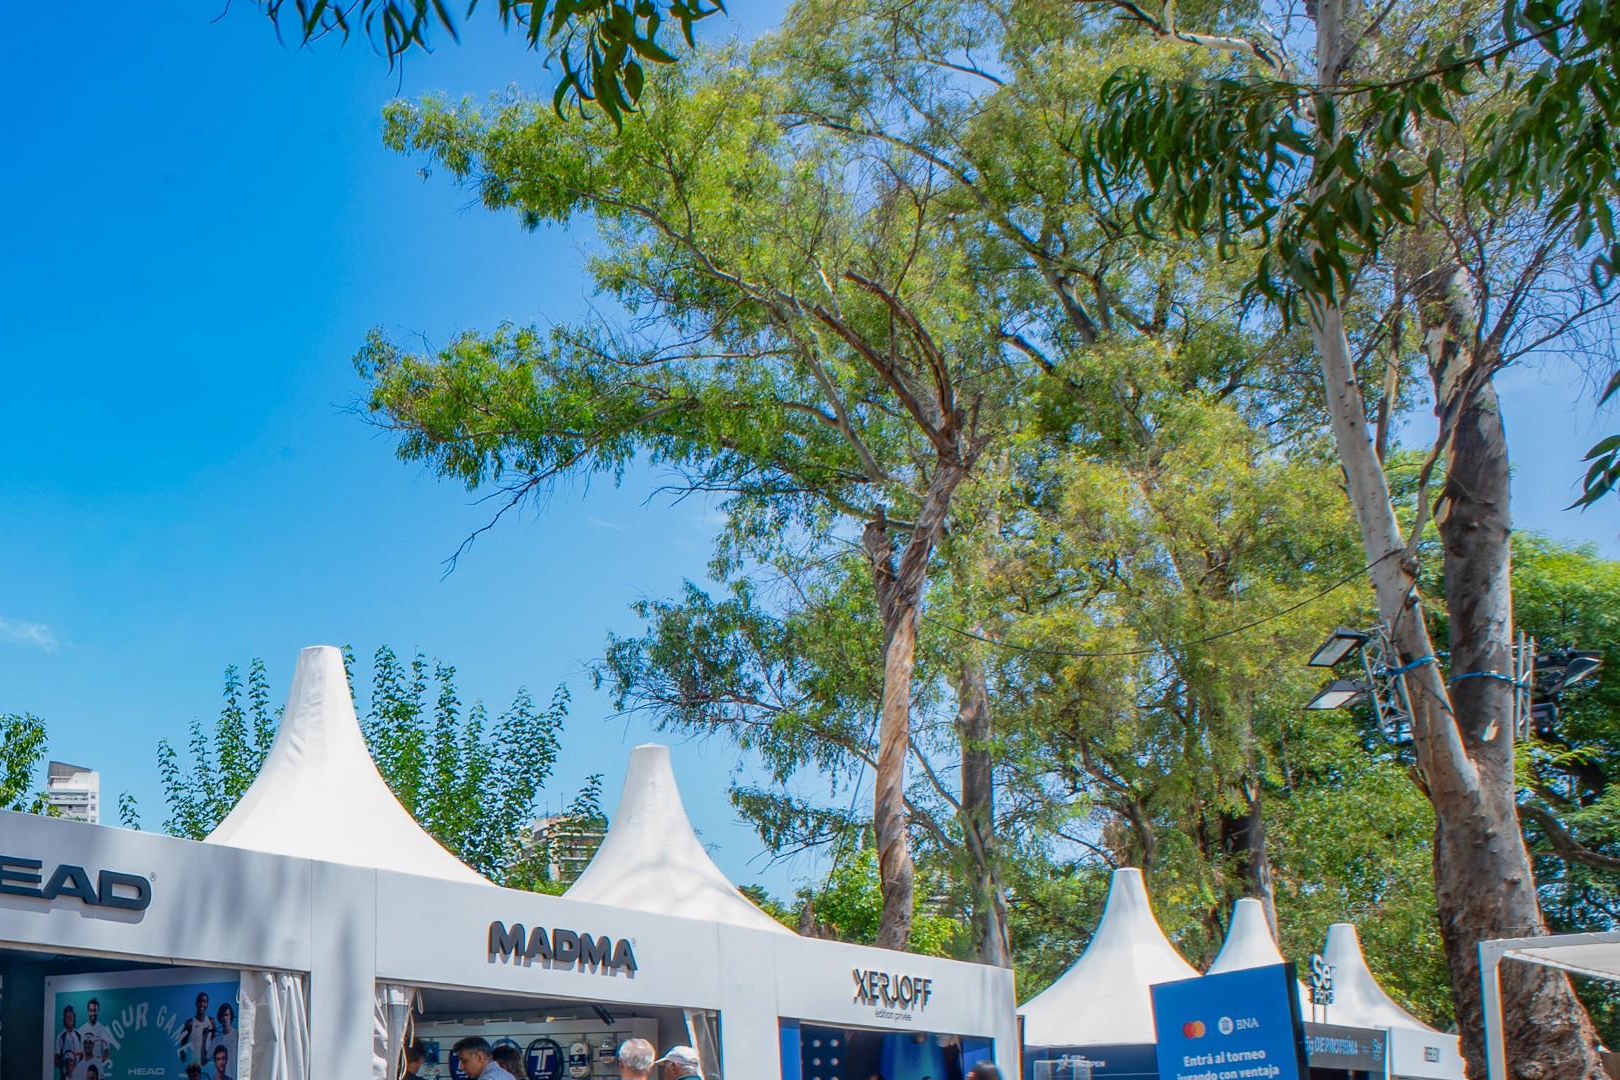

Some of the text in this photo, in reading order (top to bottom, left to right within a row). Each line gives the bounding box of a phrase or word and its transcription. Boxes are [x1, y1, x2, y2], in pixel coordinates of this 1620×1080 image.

[489, 920, 638, 971] MADMA
[852, 968, 932, 1006] XERJOFF
[156, 1004, 194, 1058] GAME
[1236, 1018, 1260, 1029] BNA
[1184, 1050, 1266, 1067] Entrá al torneo
[127, 1067, 165, 1076] HEAD
[1219, 1069, 1238, 1080] con
[1239, 1064, 1280, 1079] ventaja
